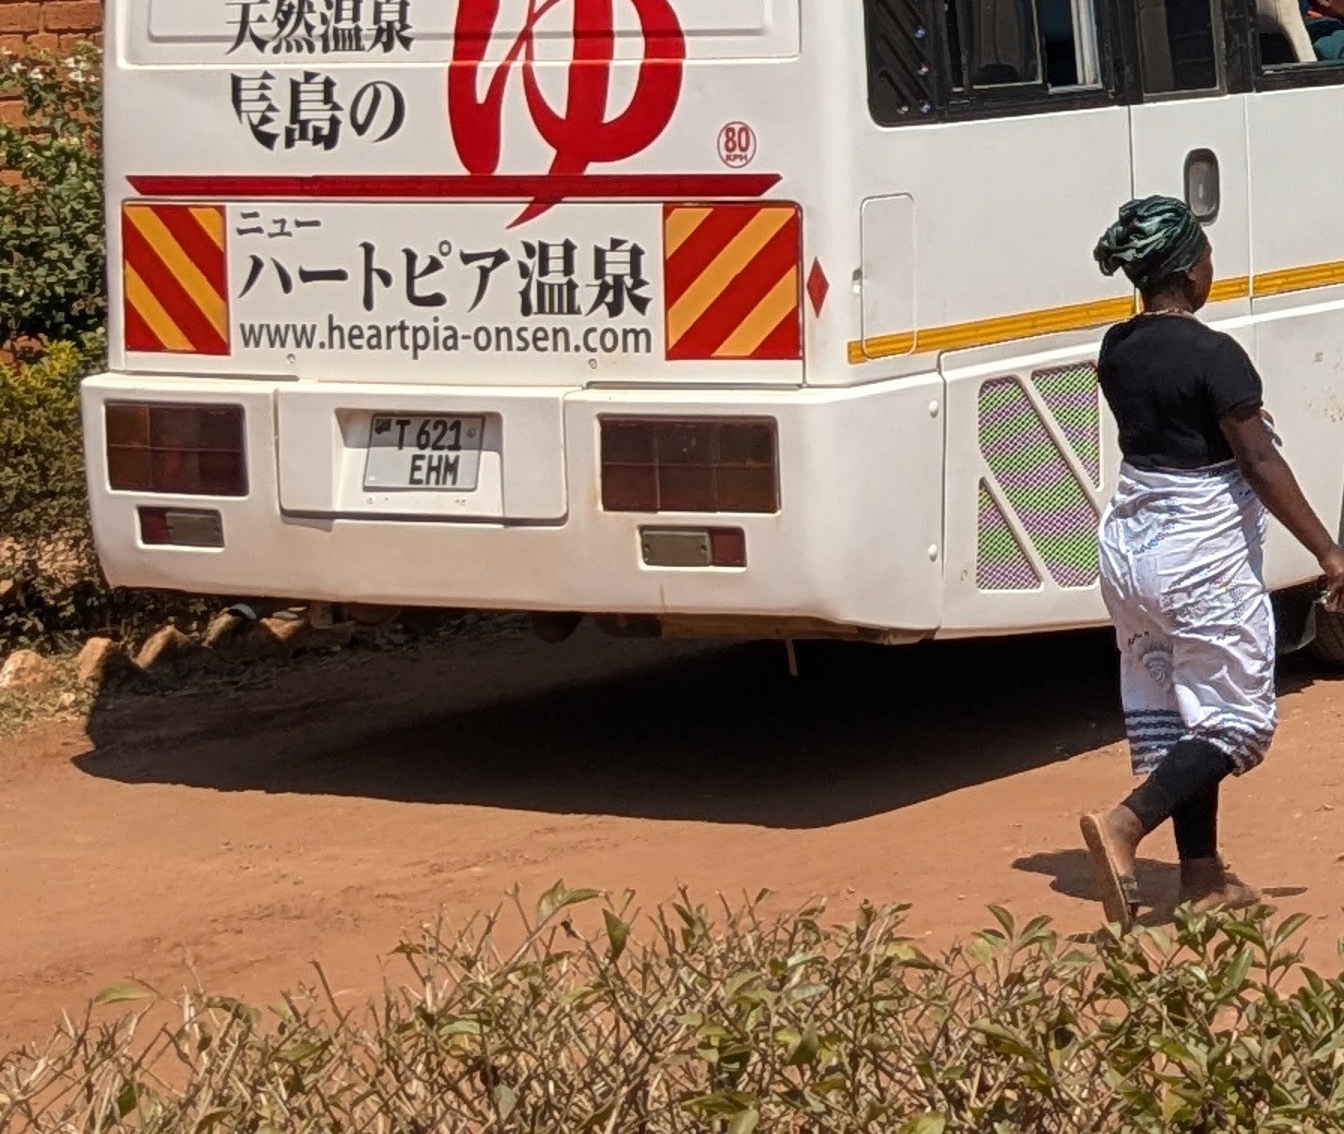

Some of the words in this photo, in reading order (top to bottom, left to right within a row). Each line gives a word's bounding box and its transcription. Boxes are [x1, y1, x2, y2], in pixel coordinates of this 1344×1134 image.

[230, 70, 406, 151] 長島の
[724, 126, 750, 153] 80
[726, 153, 748, 162] KPH
[235, 211, 322, 239] ニュー
[237, 238, 653, 318] ハートピア温泉
[240, 315, 653, 361] www.heartpia-onsen.com
[396, 419, 411, 450] T
[416, 419, 462, 451] 621
[409, 454, 460, 486] EHM
